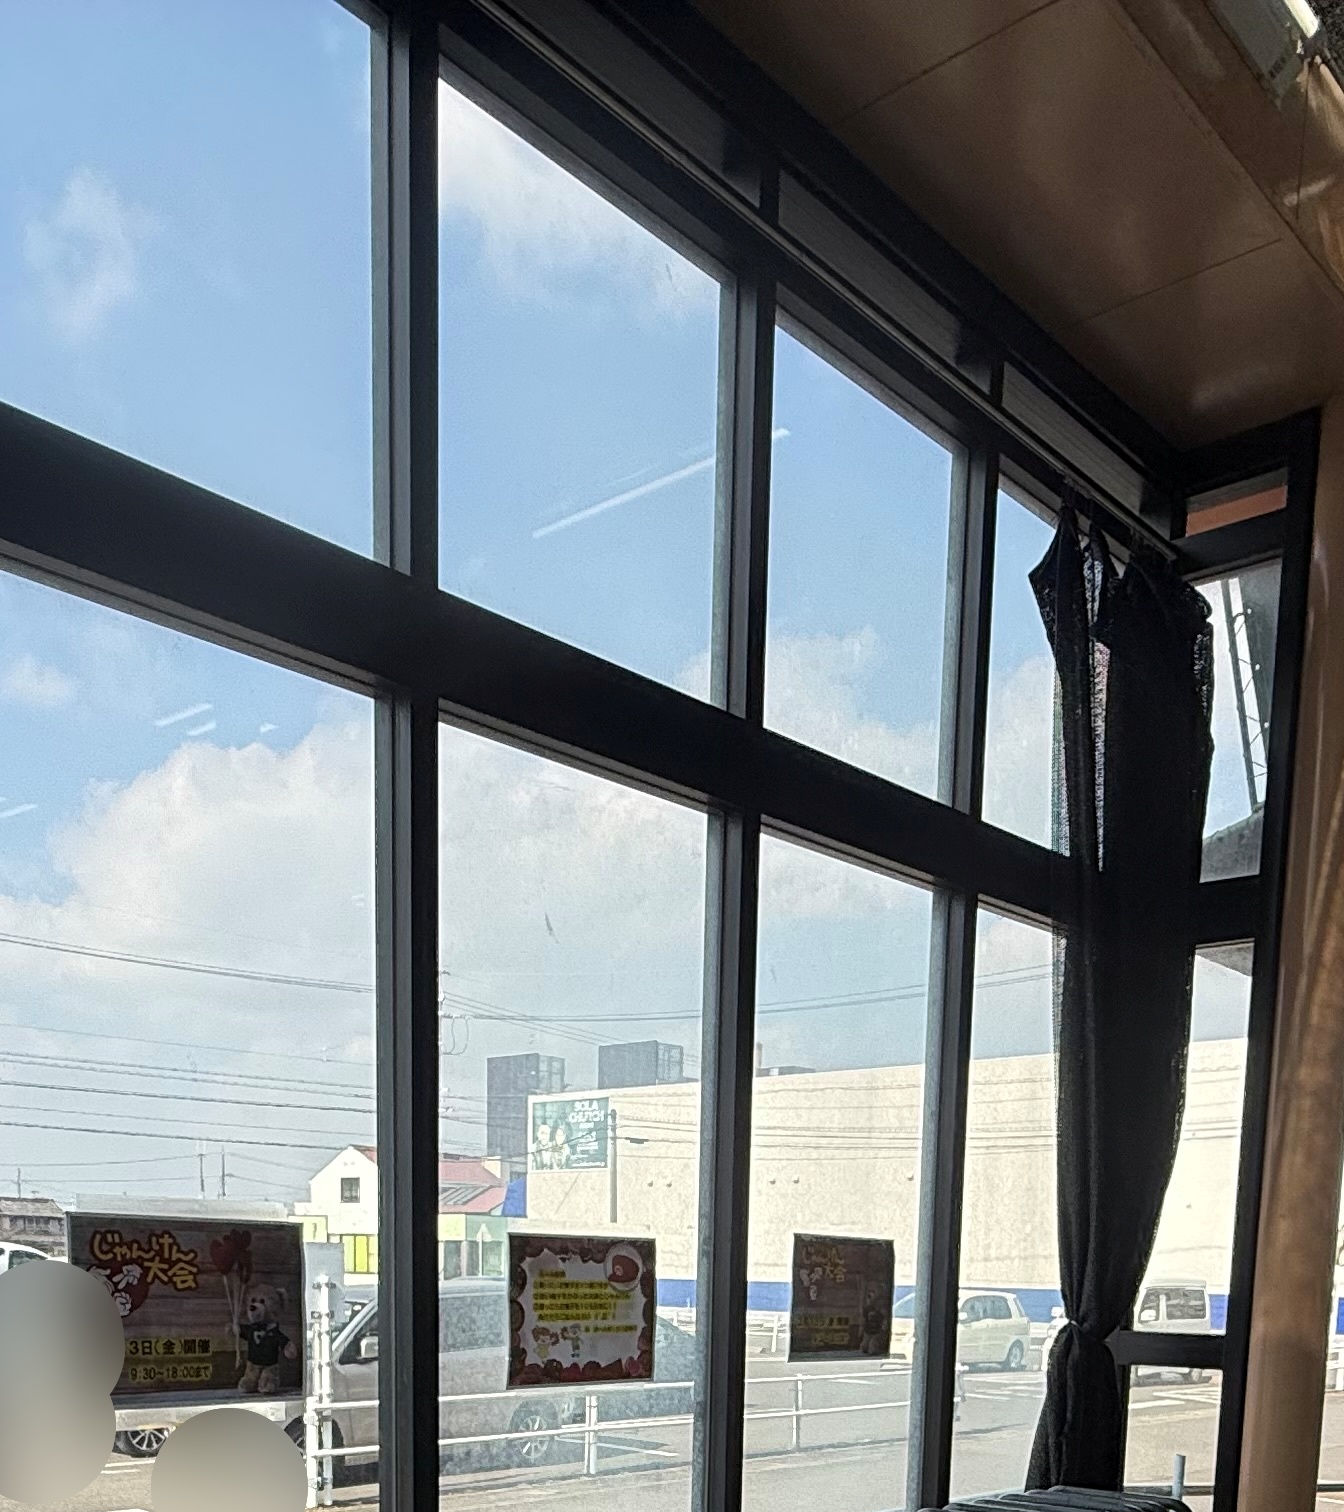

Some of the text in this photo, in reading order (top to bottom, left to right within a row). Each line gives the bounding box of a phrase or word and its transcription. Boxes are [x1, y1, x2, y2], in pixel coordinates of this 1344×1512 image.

[92, 1231, 198, 1262] じゃんけん
[144, 1257, 199, 1290] 大会
